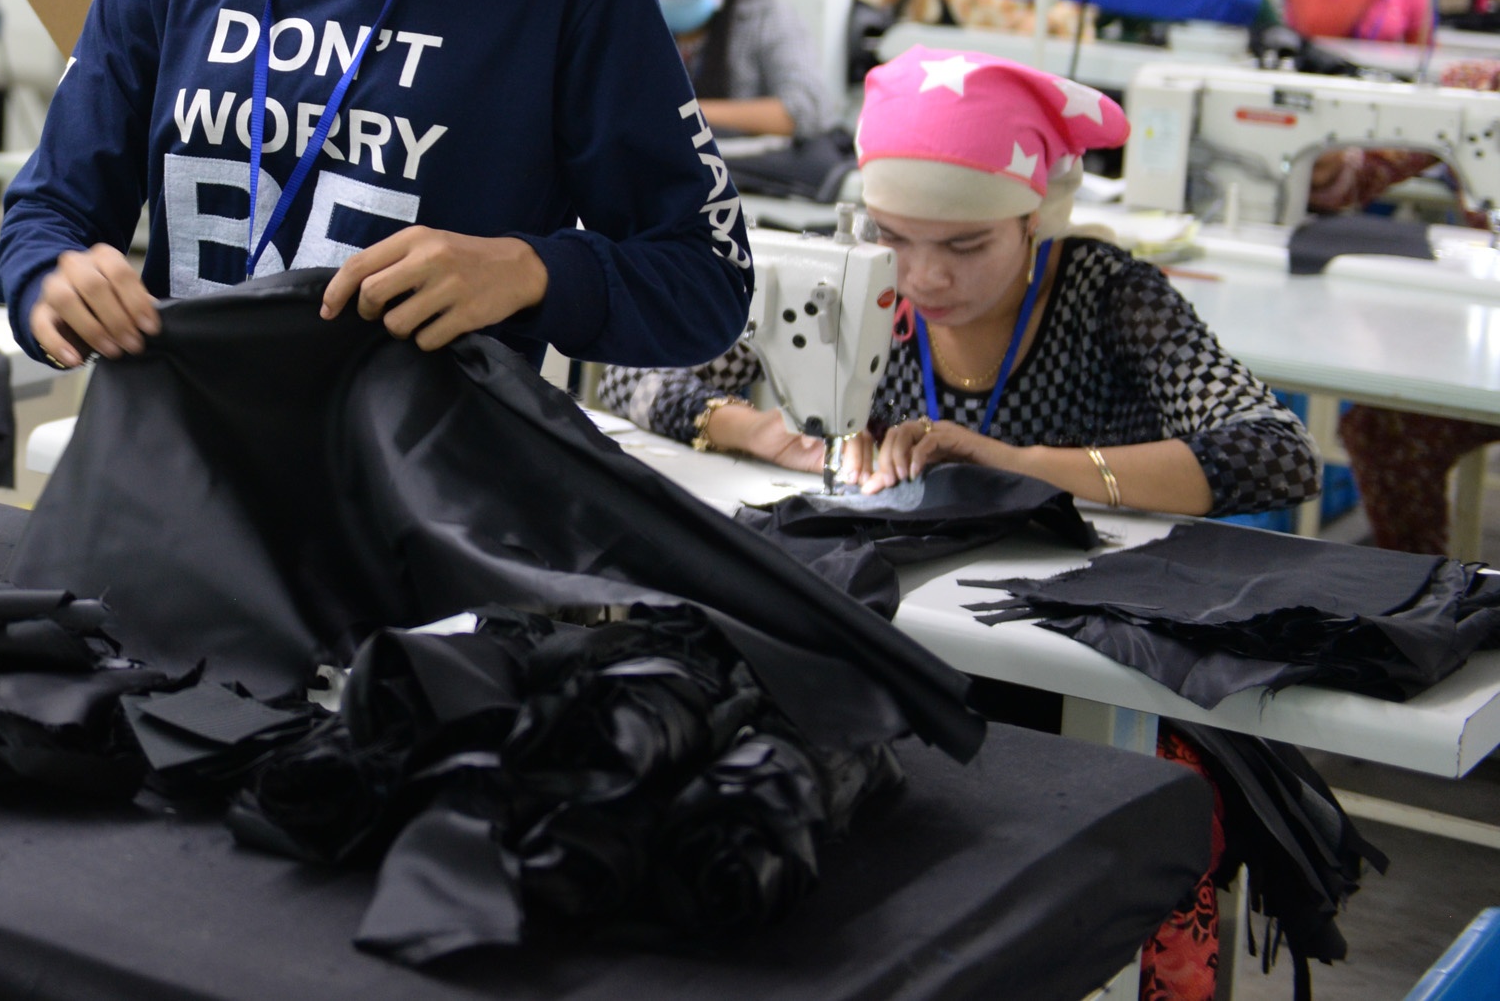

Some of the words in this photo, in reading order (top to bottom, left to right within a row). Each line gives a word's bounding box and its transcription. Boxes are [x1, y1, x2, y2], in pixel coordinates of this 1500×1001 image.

[207, 8, 443, 88] DON'T
[173, 88, 449, 180] WORRY
[164, 153, 421, 298] BE
[678, 98, 752, 292] HAPP
